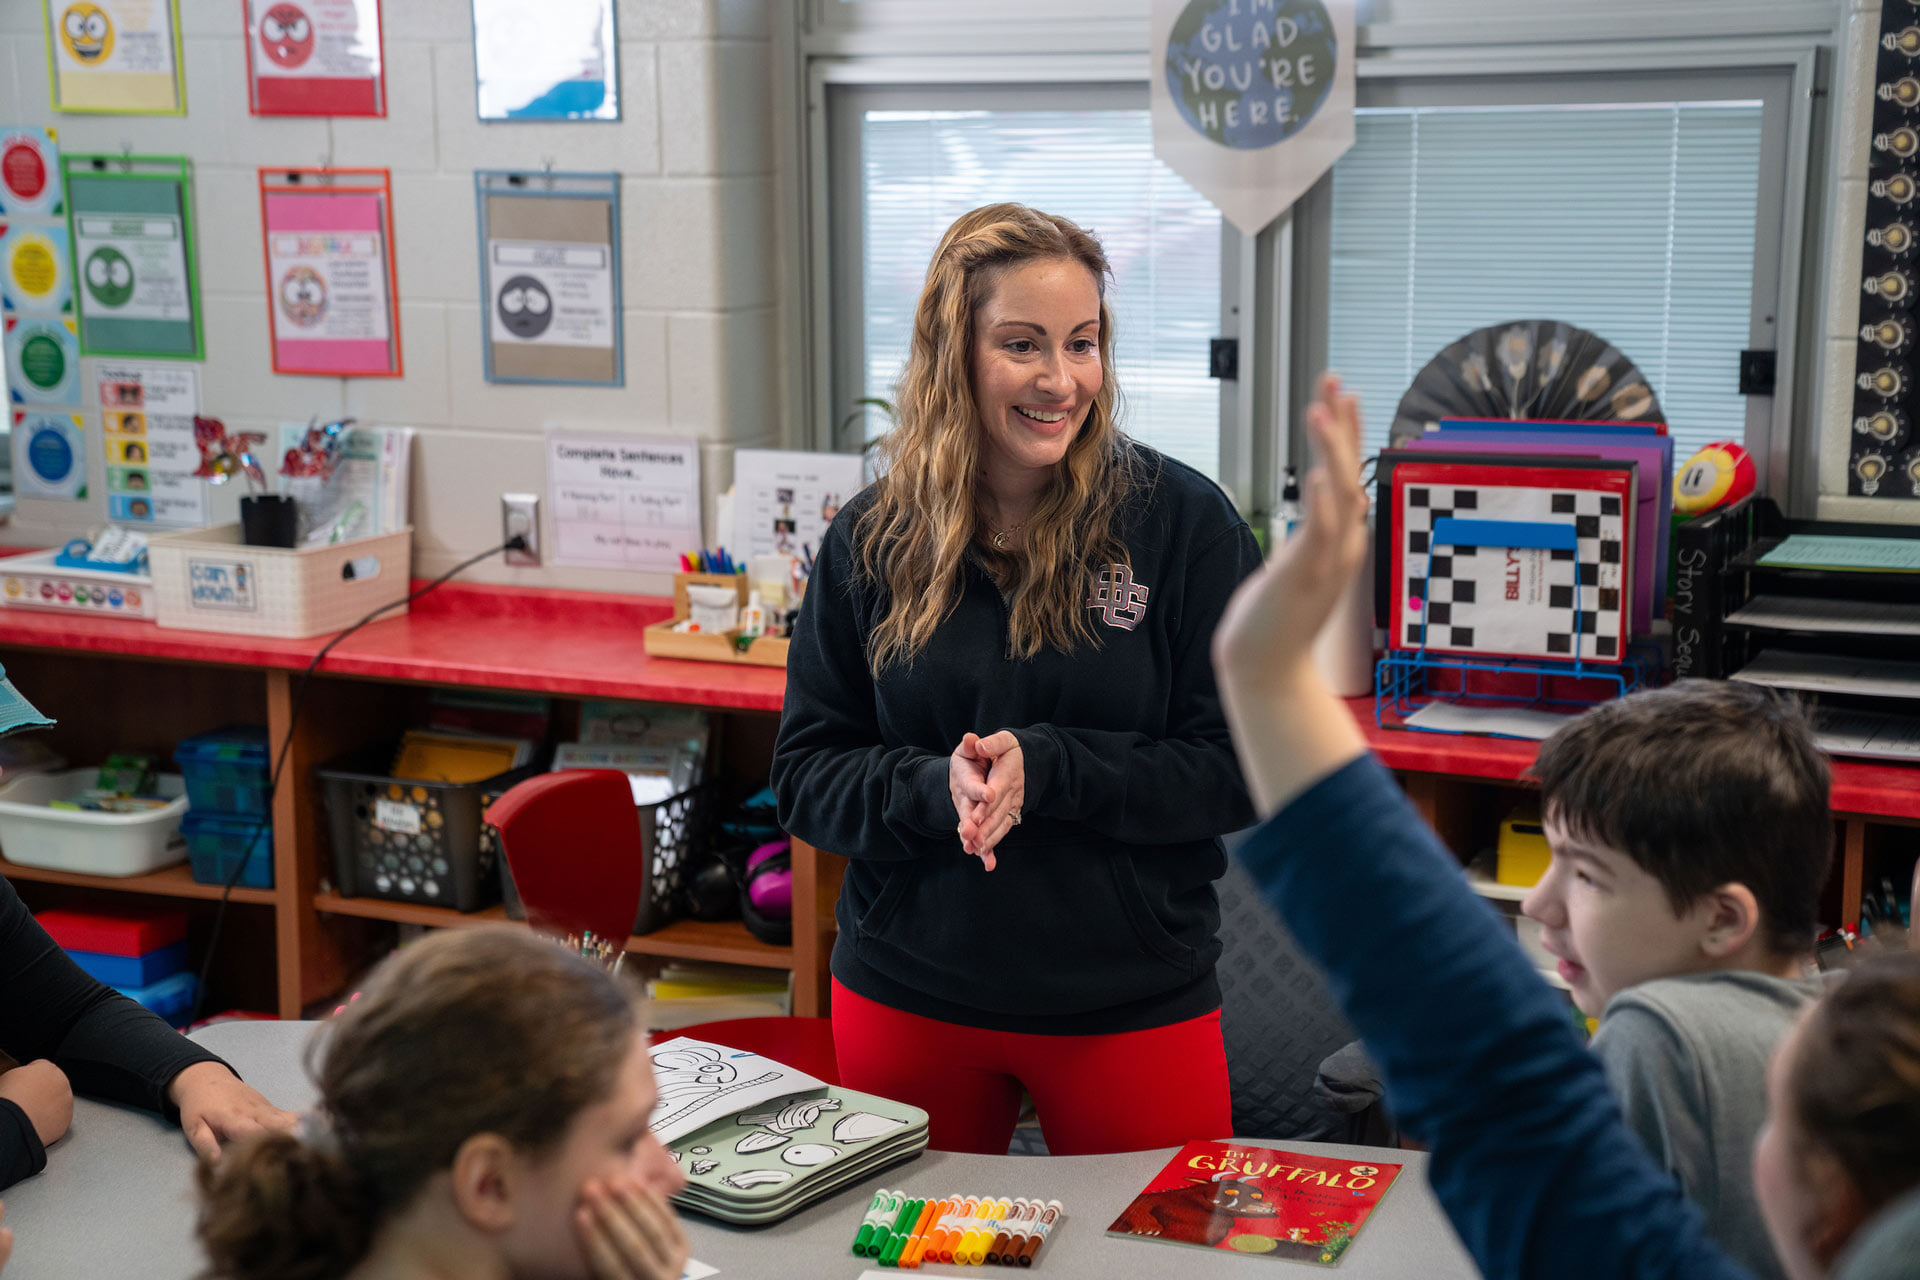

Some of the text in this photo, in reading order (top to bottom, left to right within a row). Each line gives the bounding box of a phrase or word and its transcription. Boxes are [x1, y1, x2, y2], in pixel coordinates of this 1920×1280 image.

[1201, 17, 1299, 52] GLAD
[1183, 55, 1316, 93] YOU'RE
[1198, 97, 1300, 130] HERE.
[556, 445, 685, 465] Complete Sentences
[1674, 548, 1708, 614] Story
[1188, 1154, 1377, 1190] GRUFFALO
